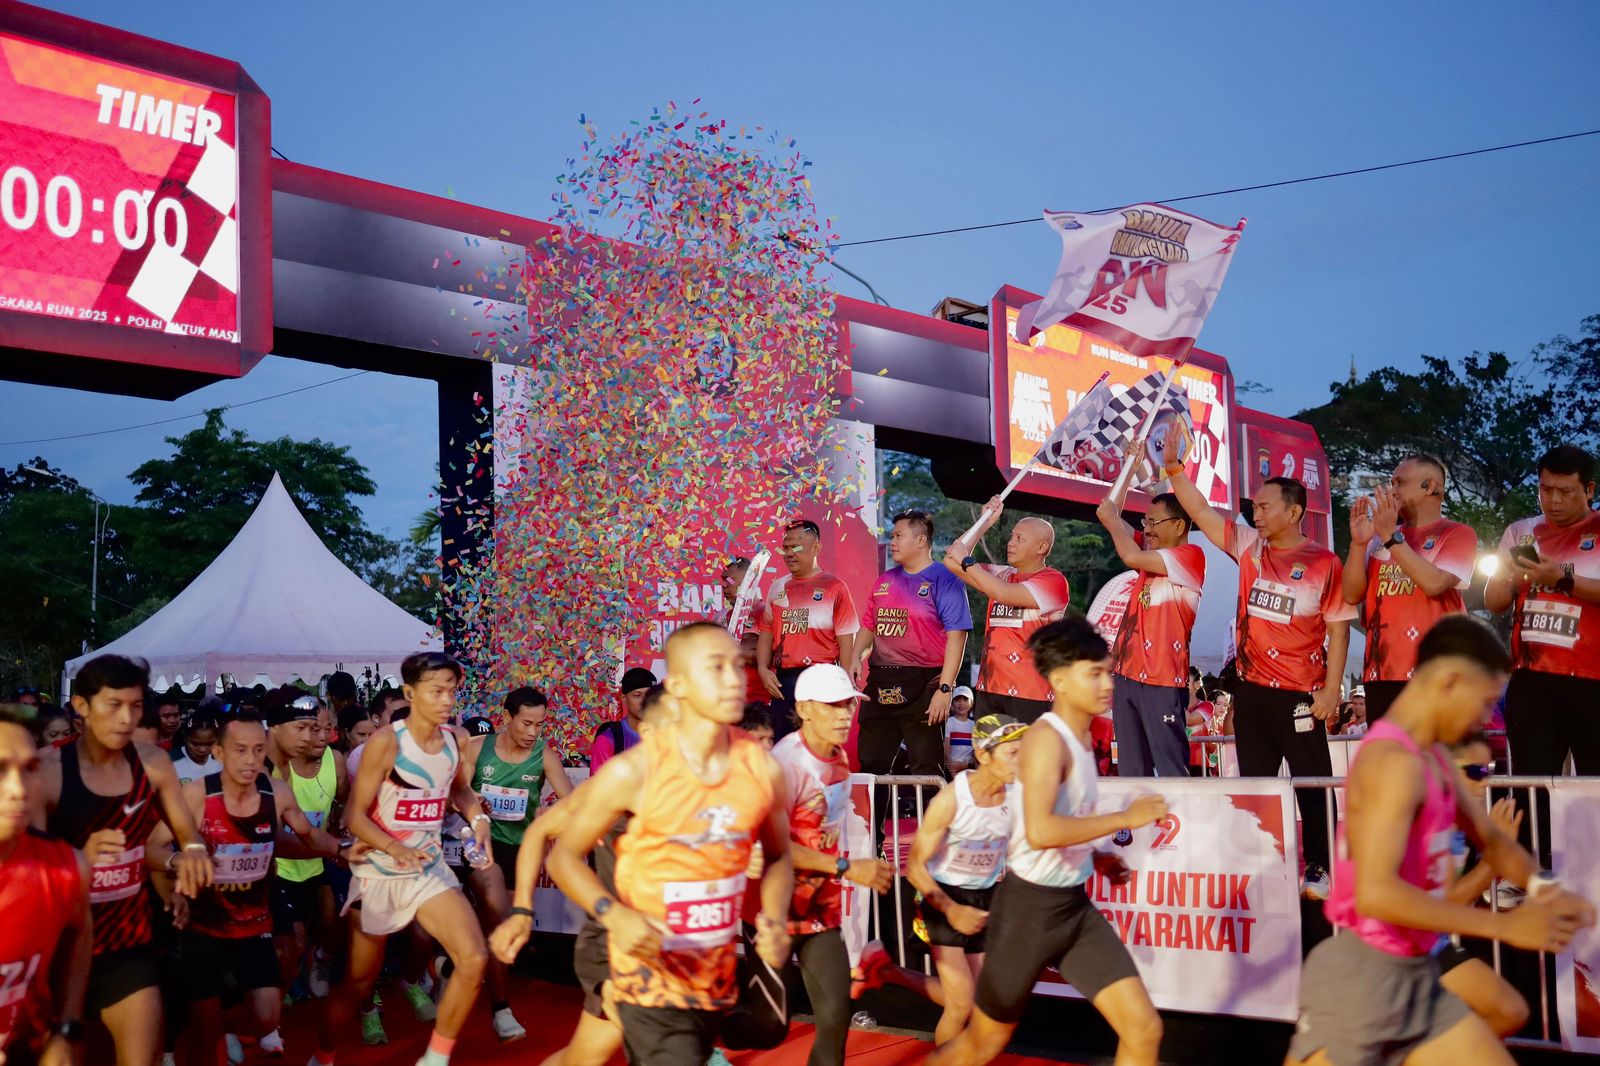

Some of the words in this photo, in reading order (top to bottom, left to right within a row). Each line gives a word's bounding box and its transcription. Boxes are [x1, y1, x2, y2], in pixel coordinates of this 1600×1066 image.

[97, 83, 222, 146] TIMER
[1121, 209, 1192, 246] BANUA
[46, 304, 76, 318] RUN
[78, 307, 108, 322] 2025
[127, 315, 163, 329] POLRI
[168, 320, 206, 336] NTUK
[1091, 343, 1109, 359] RUN
[1181, 375, 1217, 404] TIMER
[1378, 564, 1402, 574] BAN
[1376, 580, 1413, 597] RUN
[1257, 592, 1282, 610] 6918
[781, 608, 809, 618] BANUA
[877, 607, 908, 618] BANUA
[996, 604, 1014, 617] 6812
[781, 622, 809, 635] RUN
[1097, 613, 1123, 629] RU
[1532, 614, 1562, 632] 6814
[876, 623, 907, 637] RUN
[1102, 627, 1118, 636] 202
[408, 803, 439, 819] 2148
[492, 797, 516, 811] 1190
[453, 846, 464, 858] 13
[231, 857, 258, 872] 1303
[92, 867, 130, 888] 2056
[1146, 870, 1251, 911] UNTUK
[686, 901, 731, 929] 2051
[1100, 908, 1257, 954] YARAKAT
